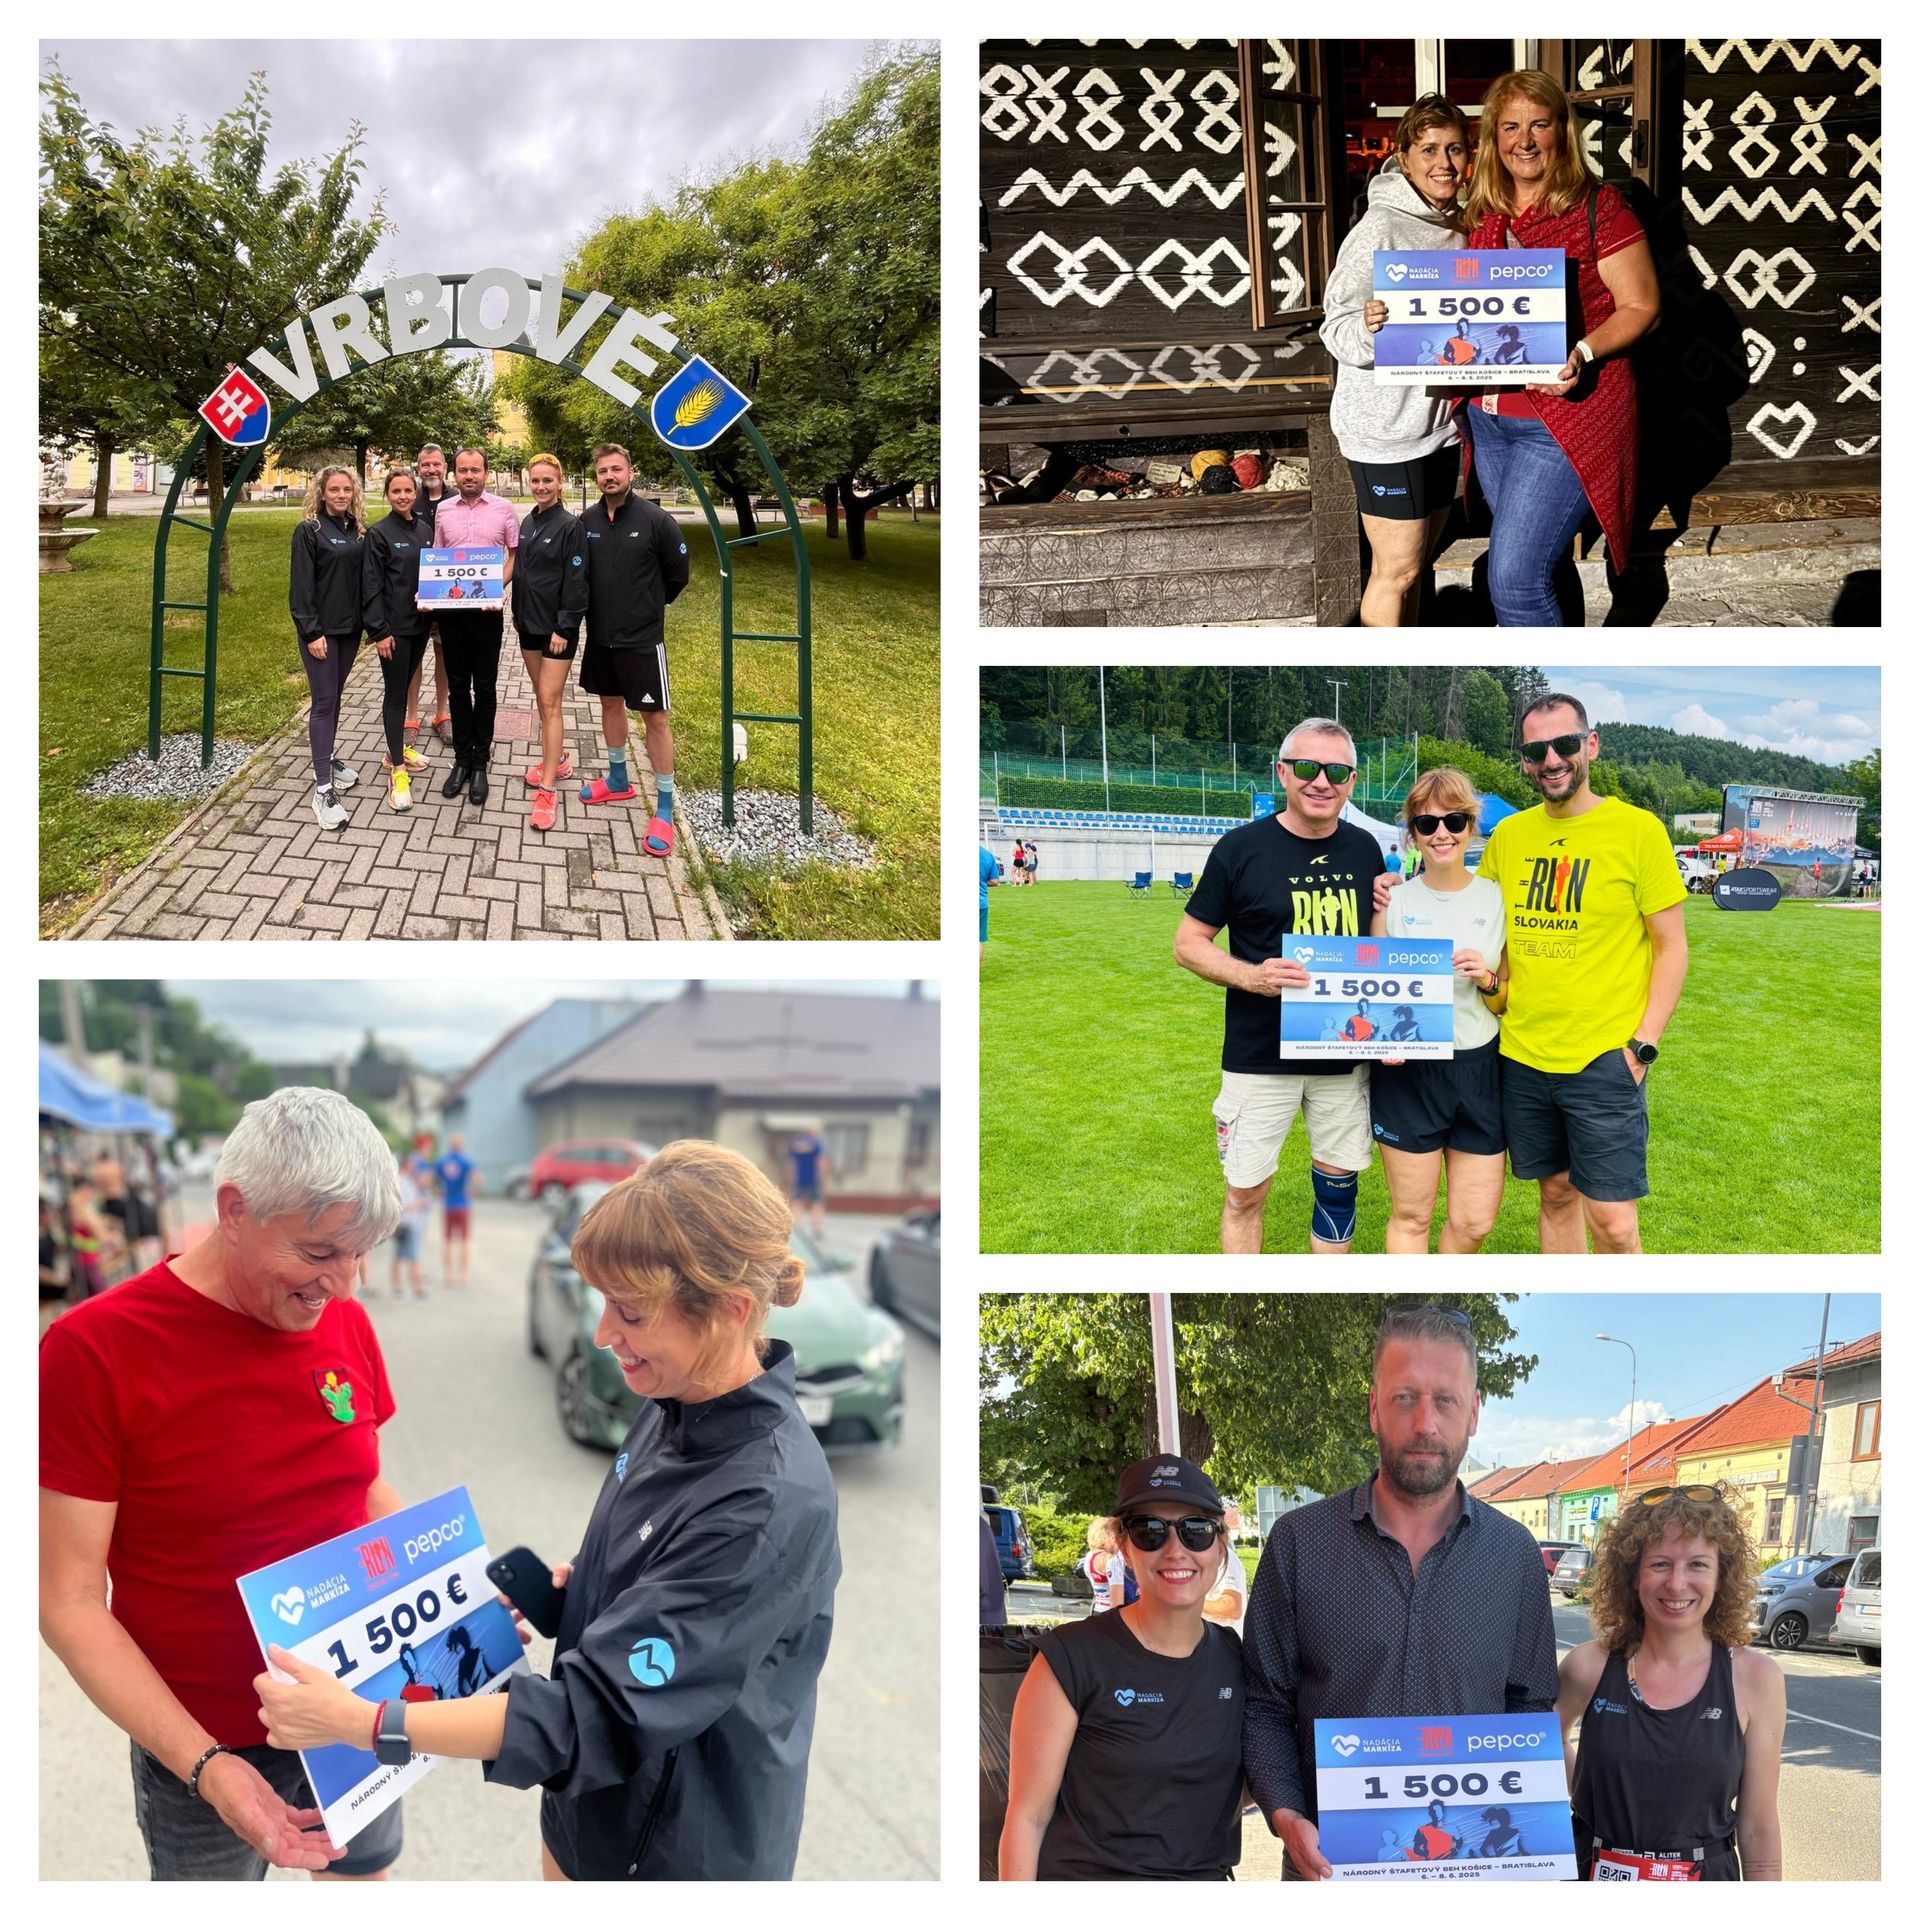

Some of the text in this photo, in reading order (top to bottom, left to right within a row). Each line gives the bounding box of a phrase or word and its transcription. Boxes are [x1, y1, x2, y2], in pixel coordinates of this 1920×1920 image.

[1409, 266, 1439, 274] NADÁCIA
[1409, 296, 1531, 316] 1 500 €
[247, 268, 677, 408] VRBOVÉ
[434, 568, 443, 577] 1
[447, 568, 476, 577] 500
[1288, 873, 1354, 884] VOLVO
[1525, 856, 1591, 913] RUN
[1514, 915, 1578, 930] SLOVAKIA
[1512, 939, 1577, 960] TEAM
[1314, 979, 1423, 997] 1 500 €
[306, 1573, 347, 1598] NADÁCIA
[311, 1583, 351, 1609] MARKÍZA
[327, 1639, 358, 1680] 1
[365, 1589, 441, 1655] 500
[446, 1573, 468, 1604] €
[1363, 1738, 1400, 1746] NADÁCIA
[1363, 1744, 1402, 1753] MARKÍZA
[351, 1771, 392, 1810] NÁRODNÝ
[1364, 1771, 1522, 1799] 1 500 €
[1343, 1868, 1387, 1876] NÁRODNÝ
[1389, 1866, 1440, 1874] ŠTAFETOVÝ
[1501, 1861, 1555, 1869] BRATISLAVA
